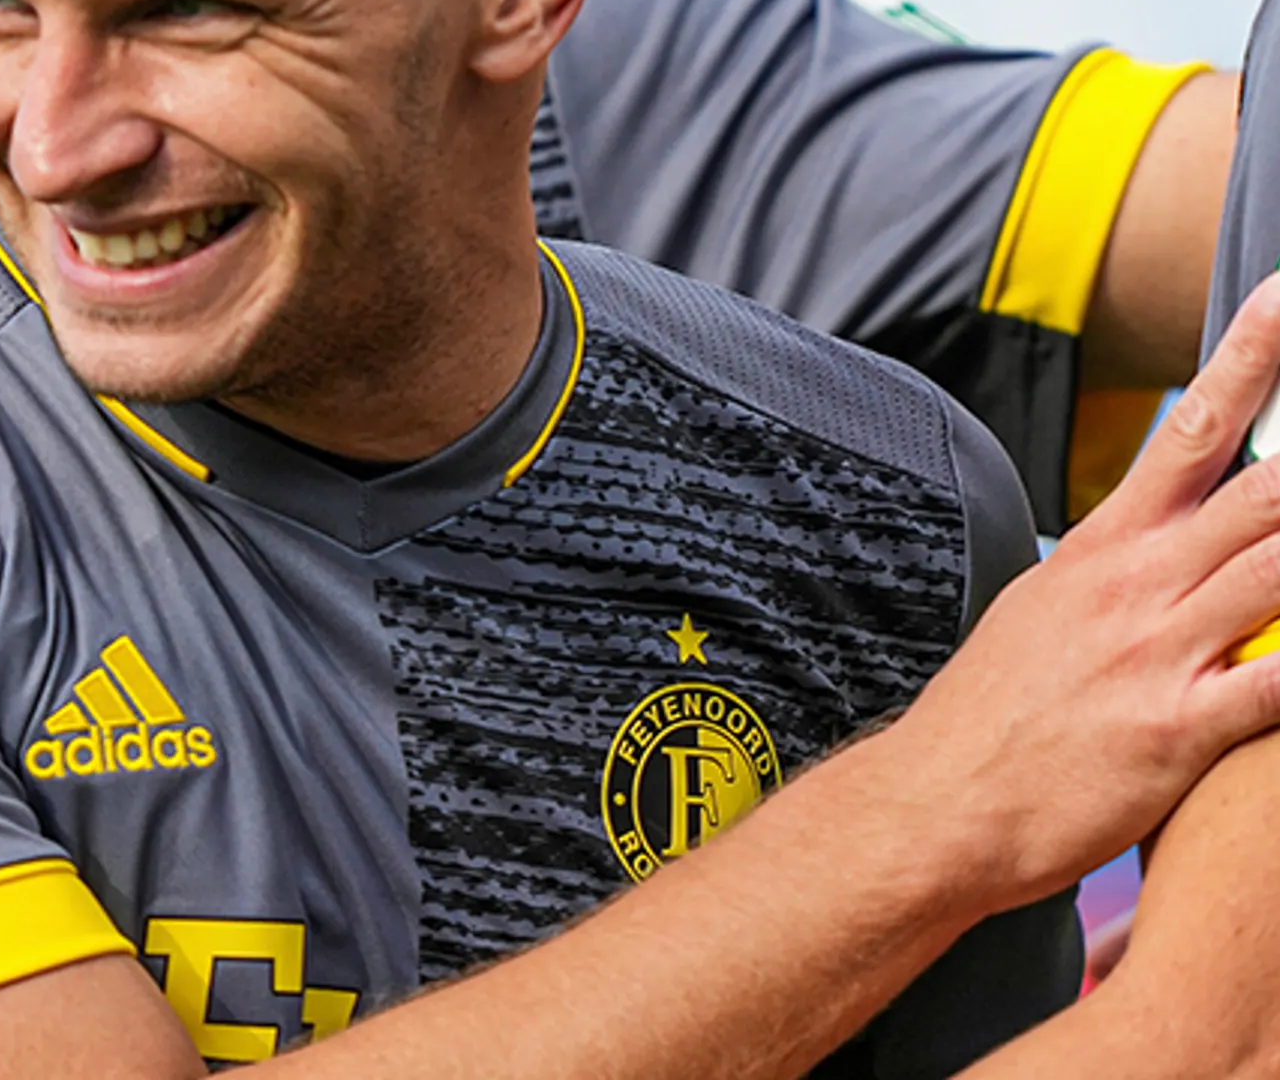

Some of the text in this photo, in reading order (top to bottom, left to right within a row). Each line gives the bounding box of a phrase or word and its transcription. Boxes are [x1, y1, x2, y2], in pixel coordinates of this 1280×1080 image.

[25, 724, 218, 780] adidas
[619, 692, 772, 776] FEYENOORD
[660, 746, 736, 856] F
